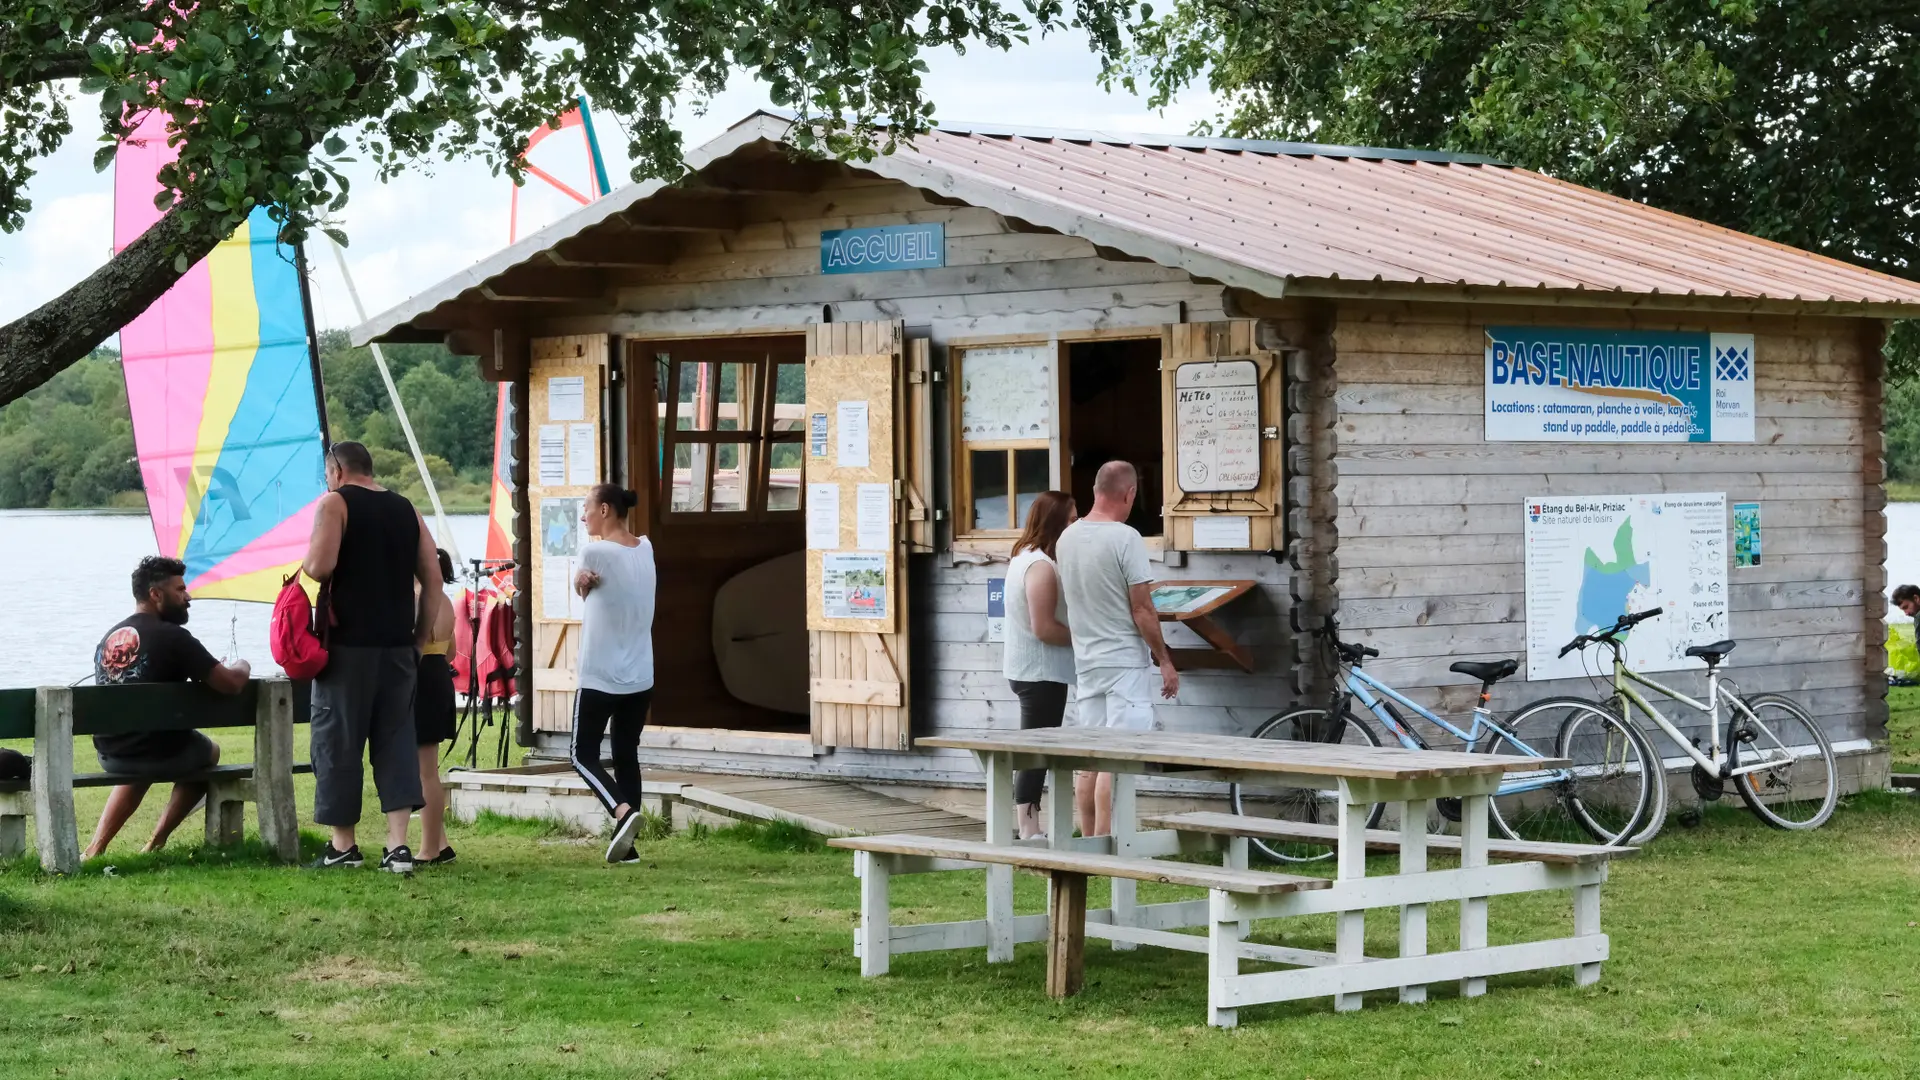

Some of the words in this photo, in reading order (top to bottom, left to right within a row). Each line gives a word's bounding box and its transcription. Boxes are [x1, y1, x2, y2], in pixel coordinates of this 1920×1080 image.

[828, 231, 937, 267] ACCUEIL
[1492, 341, 1562, 386] BASE
[1567, 343, 1700, 396] NAUTIQUE
[1492, 400, 1535, 413] Locations
[1543, 403, 1595, 416] catamaran,
[1597, 402, 1631, 417] planche
[1634, 403, 1640, 415] à
[1642, 403, 1666, 417] voile,
[1668, 402, 1698, 418] kayak,
[1716, 400, 1740, 409] Morvan
[1543, 420, 1568, 433] stand
[1571, 424, 1582, 435] up
[1585, 420, 1619, 435] paddle,
[1621, 421, 1652, 435] paddle
[1654, 421, 1660, 433] à
[1542, 503, 1563, 514] Étang
[1565, 504, 1574, 513] du
[1576, 503, 1601, 513] Bel-Air,
[1603, 502, 1625, 512] Priziac
[1542, 515, 1556, 525] Site
[1558, 515, 1580, 524] naturel
[1582, 515, 1592, 524] de
[1593, 514, 1613, 523] loisirs
